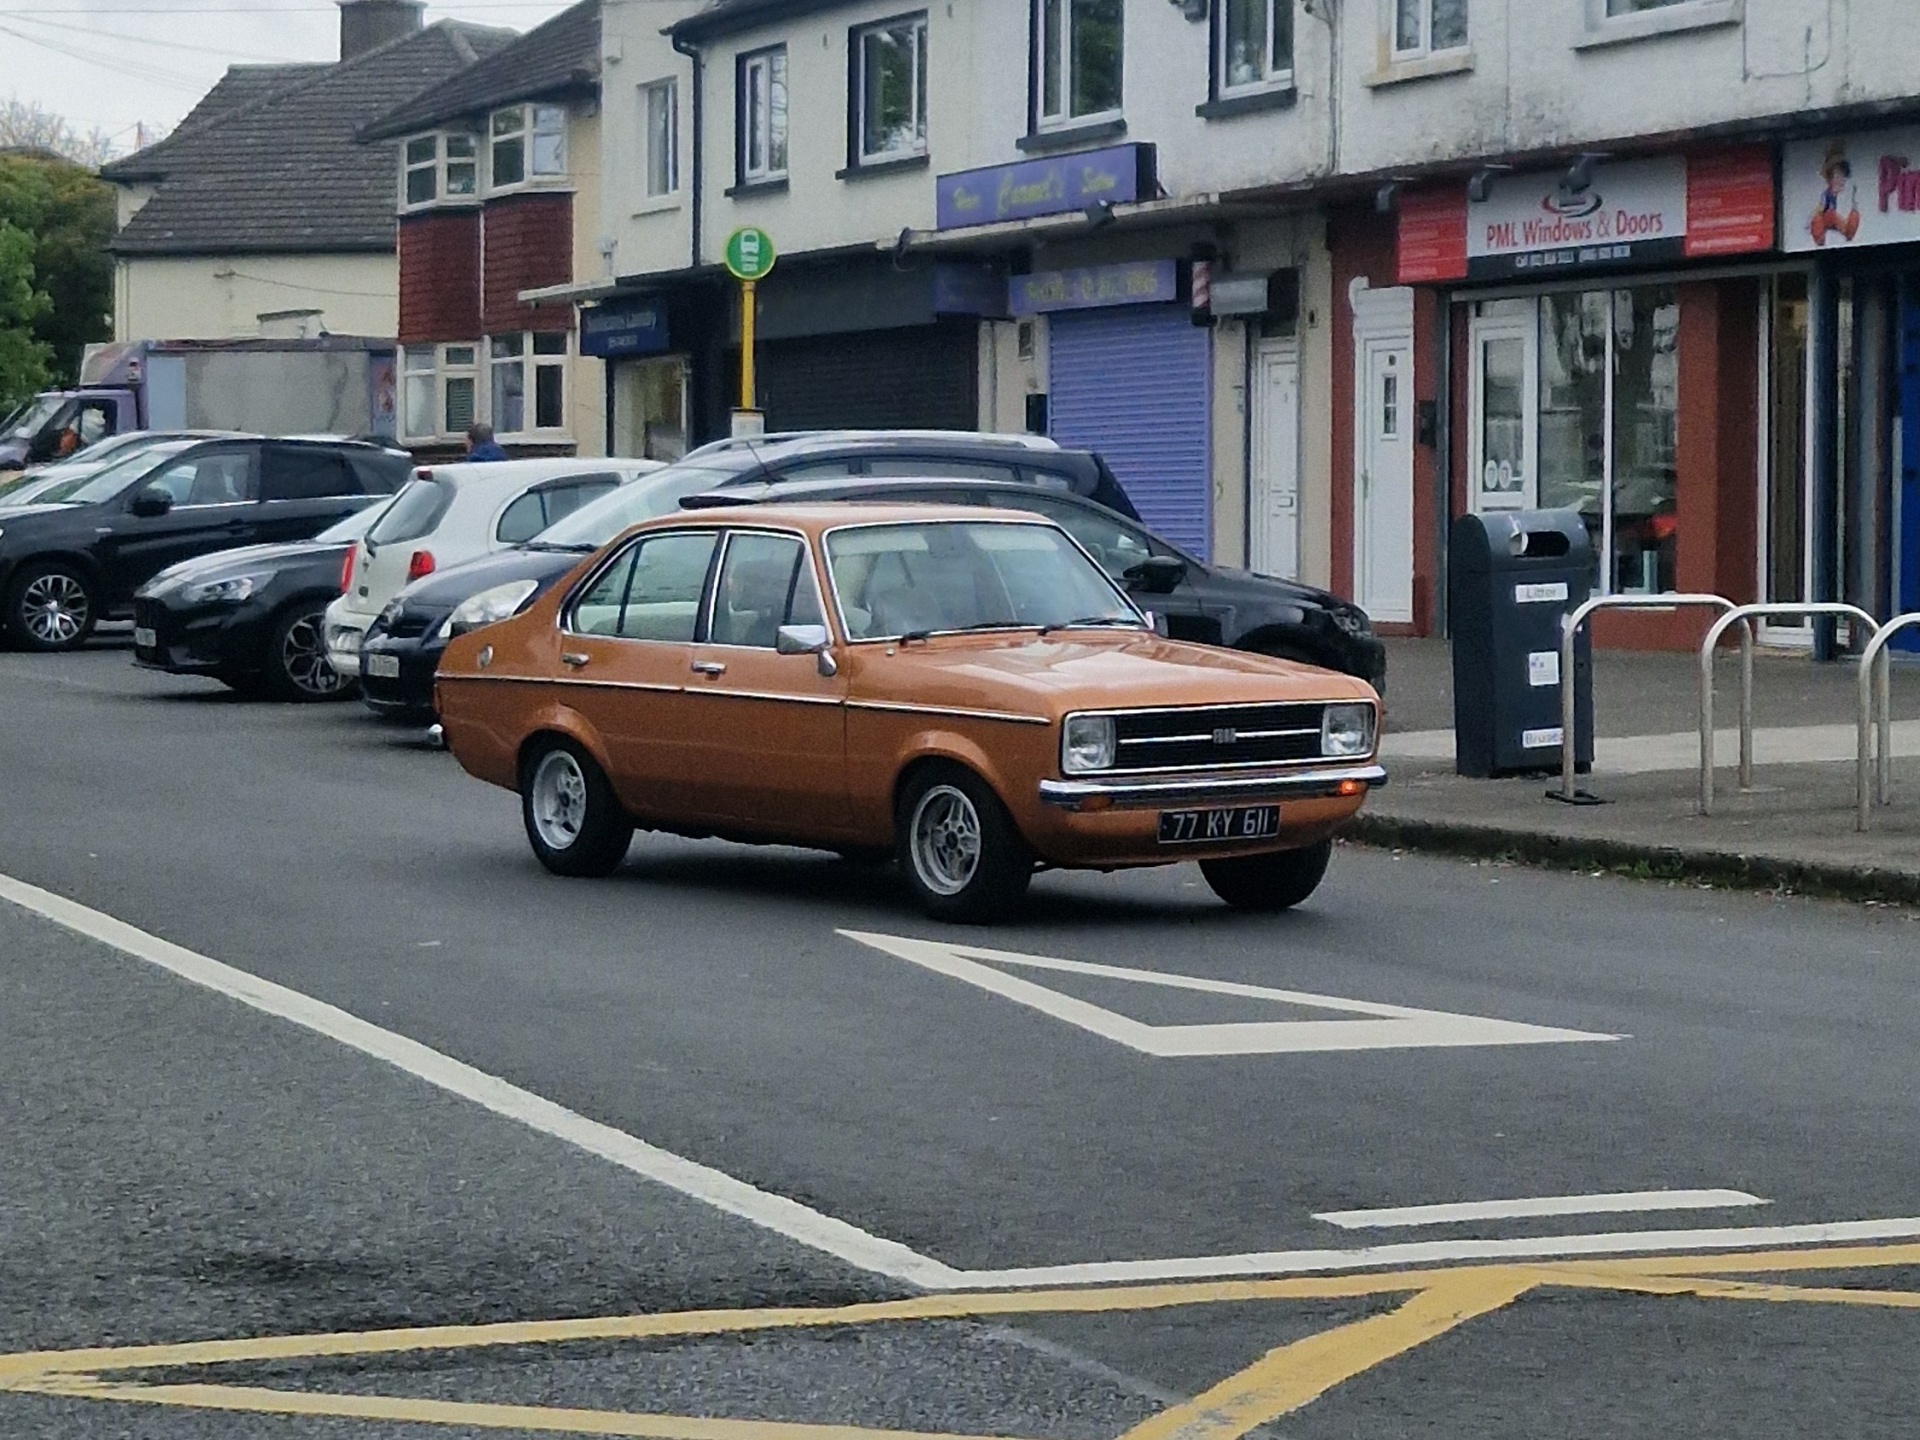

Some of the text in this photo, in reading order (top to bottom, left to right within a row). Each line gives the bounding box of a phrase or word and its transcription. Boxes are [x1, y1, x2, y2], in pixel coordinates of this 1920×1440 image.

[1486, 222, 1518, 248] PML
[1523, 216, 1592, 246] Windows
[1597, 211, 1610, 237] &
[1616, 209, 1663, 236] Doors
[1172, 808, 1269, 838] 77 KY 611
